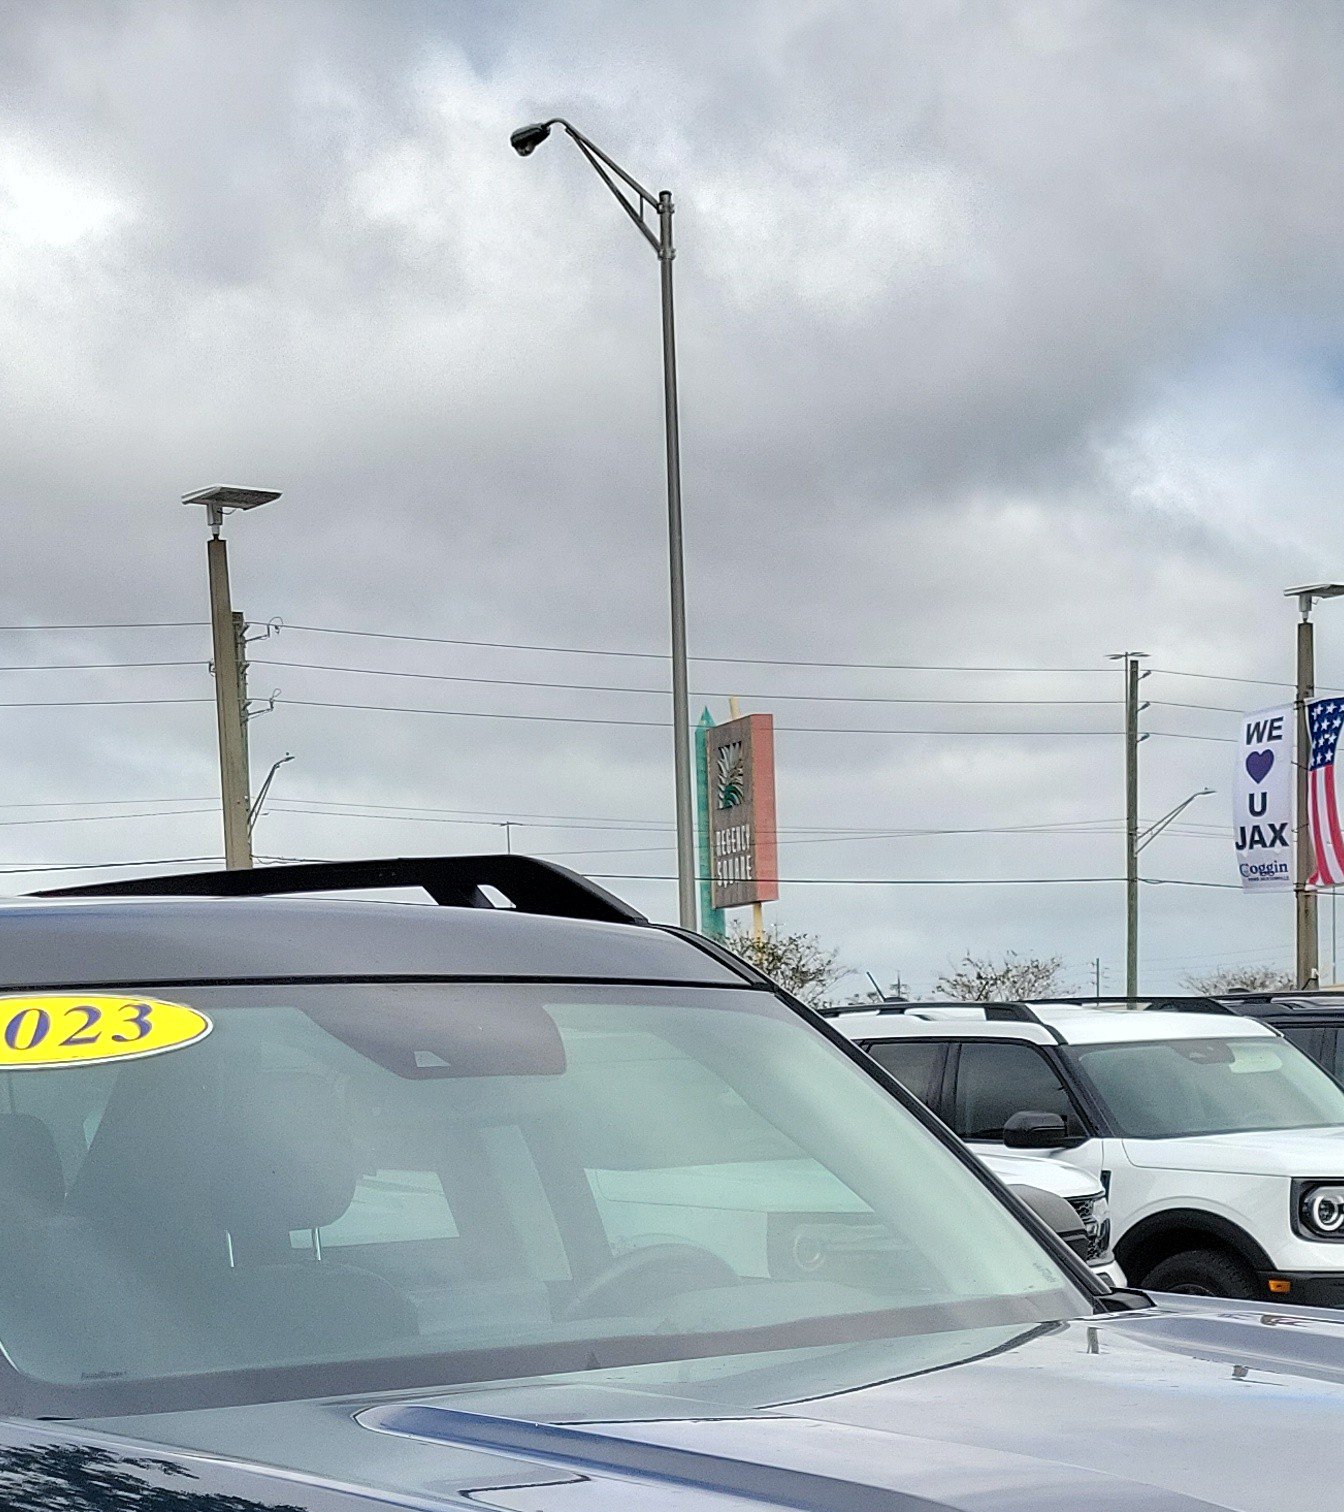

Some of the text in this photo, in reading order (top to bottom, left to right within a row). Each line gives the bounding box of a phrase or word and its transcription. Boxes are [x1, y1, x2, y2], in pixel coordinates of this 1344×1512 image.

[1246, 716, 1284, 746] WE
[1248, 792, 1267, 818] U
[1235, 822, 1289, 850] JAX
[1239, 860, 1289, 878] Coggin
